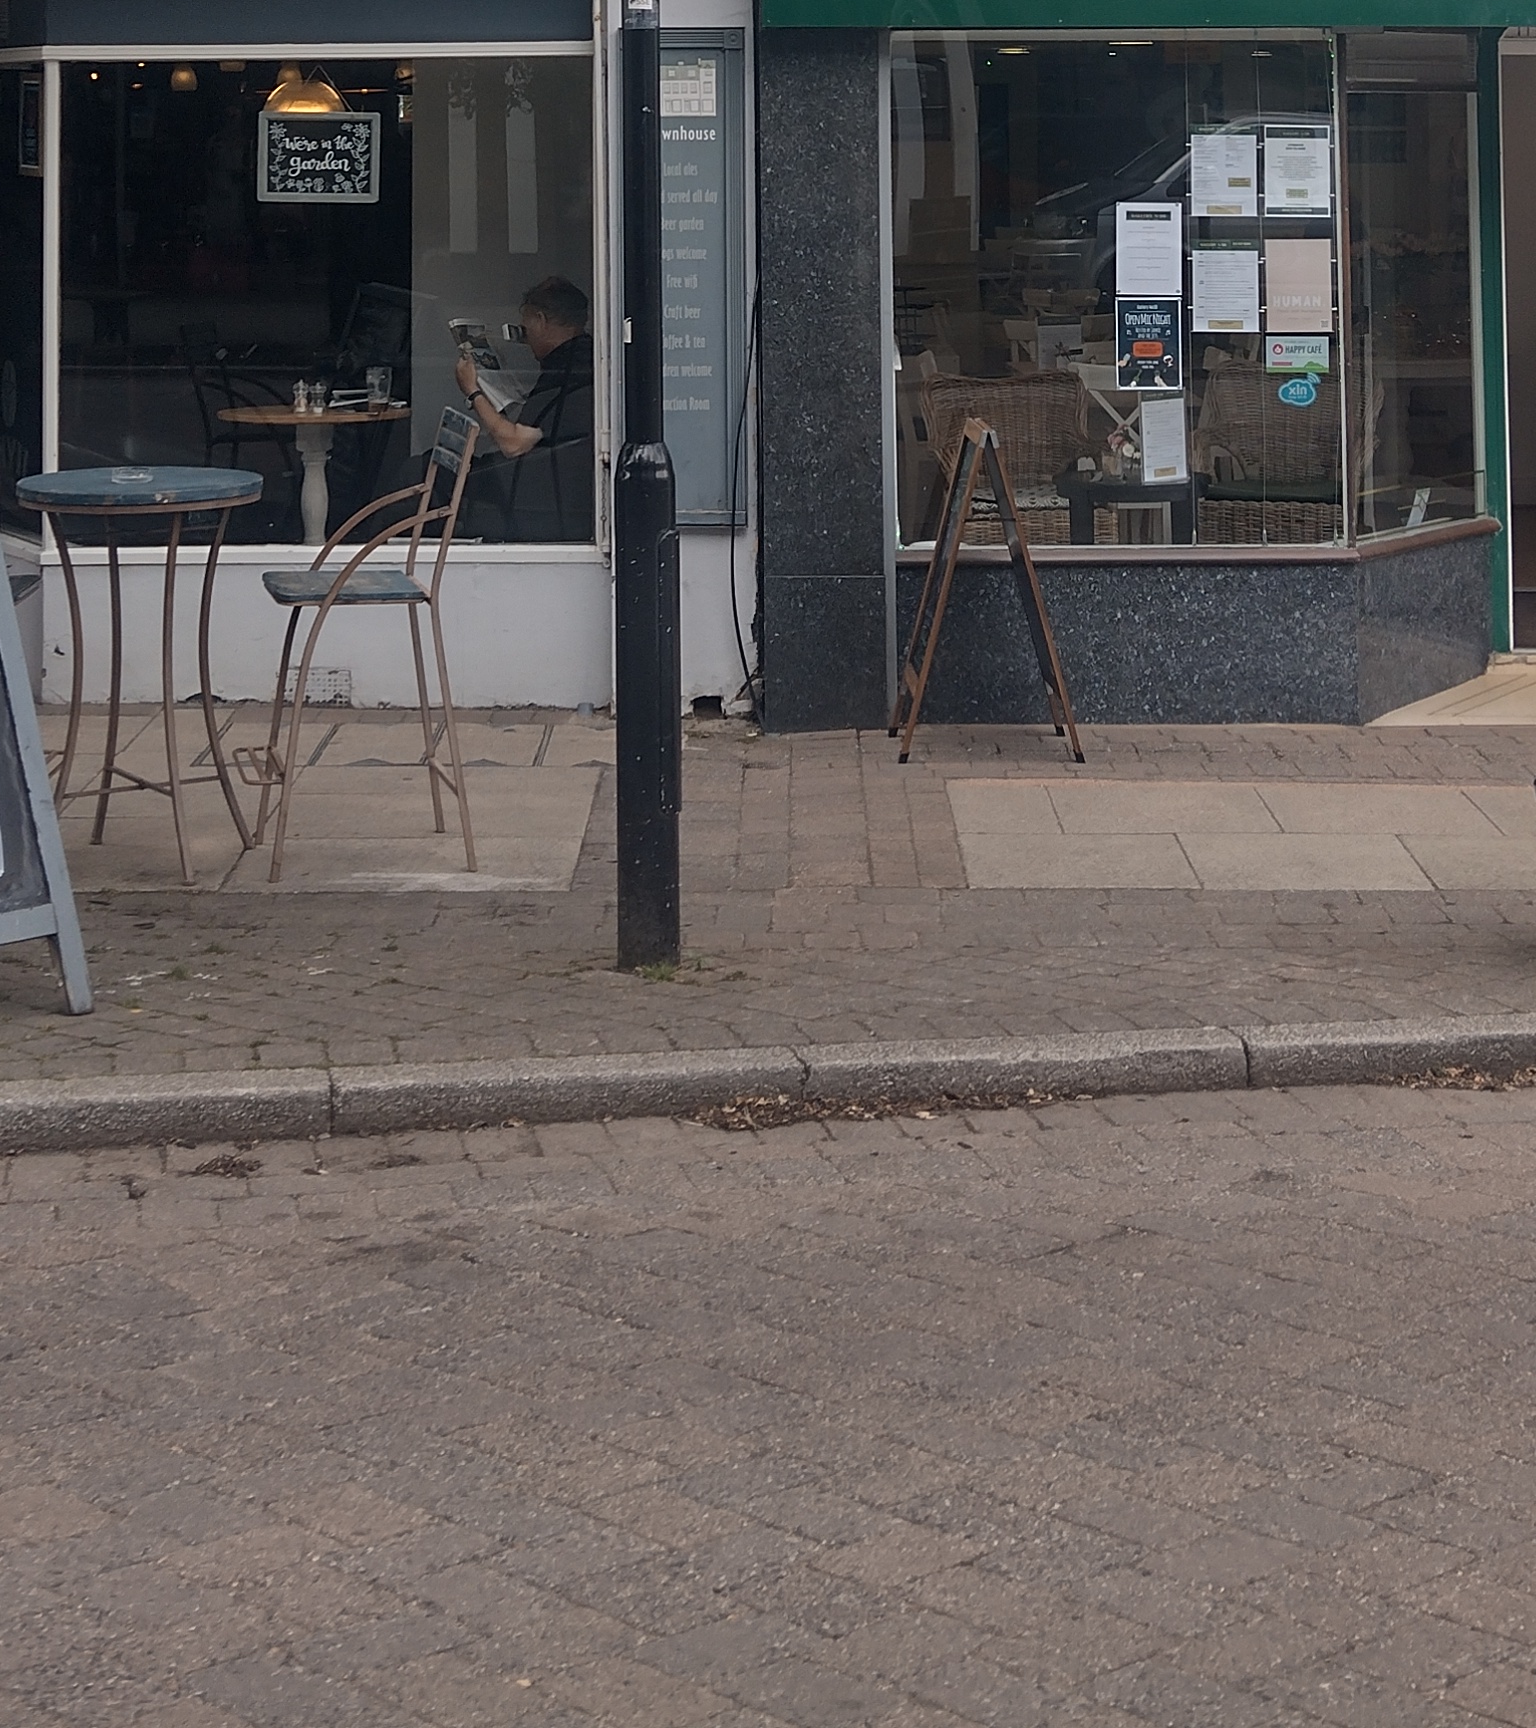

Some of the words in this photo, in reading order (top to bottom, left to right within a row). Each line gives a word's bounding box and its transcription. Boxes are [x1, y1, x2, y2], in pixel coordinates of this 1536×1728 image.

[662, 125, 716, 140] wnhouse
[321, 138, 332, 150] in
[288, 151, 351, 177] garden
[663, 334, 683, 350] offee
[1285, 345, 1305, 354] HAPPY
